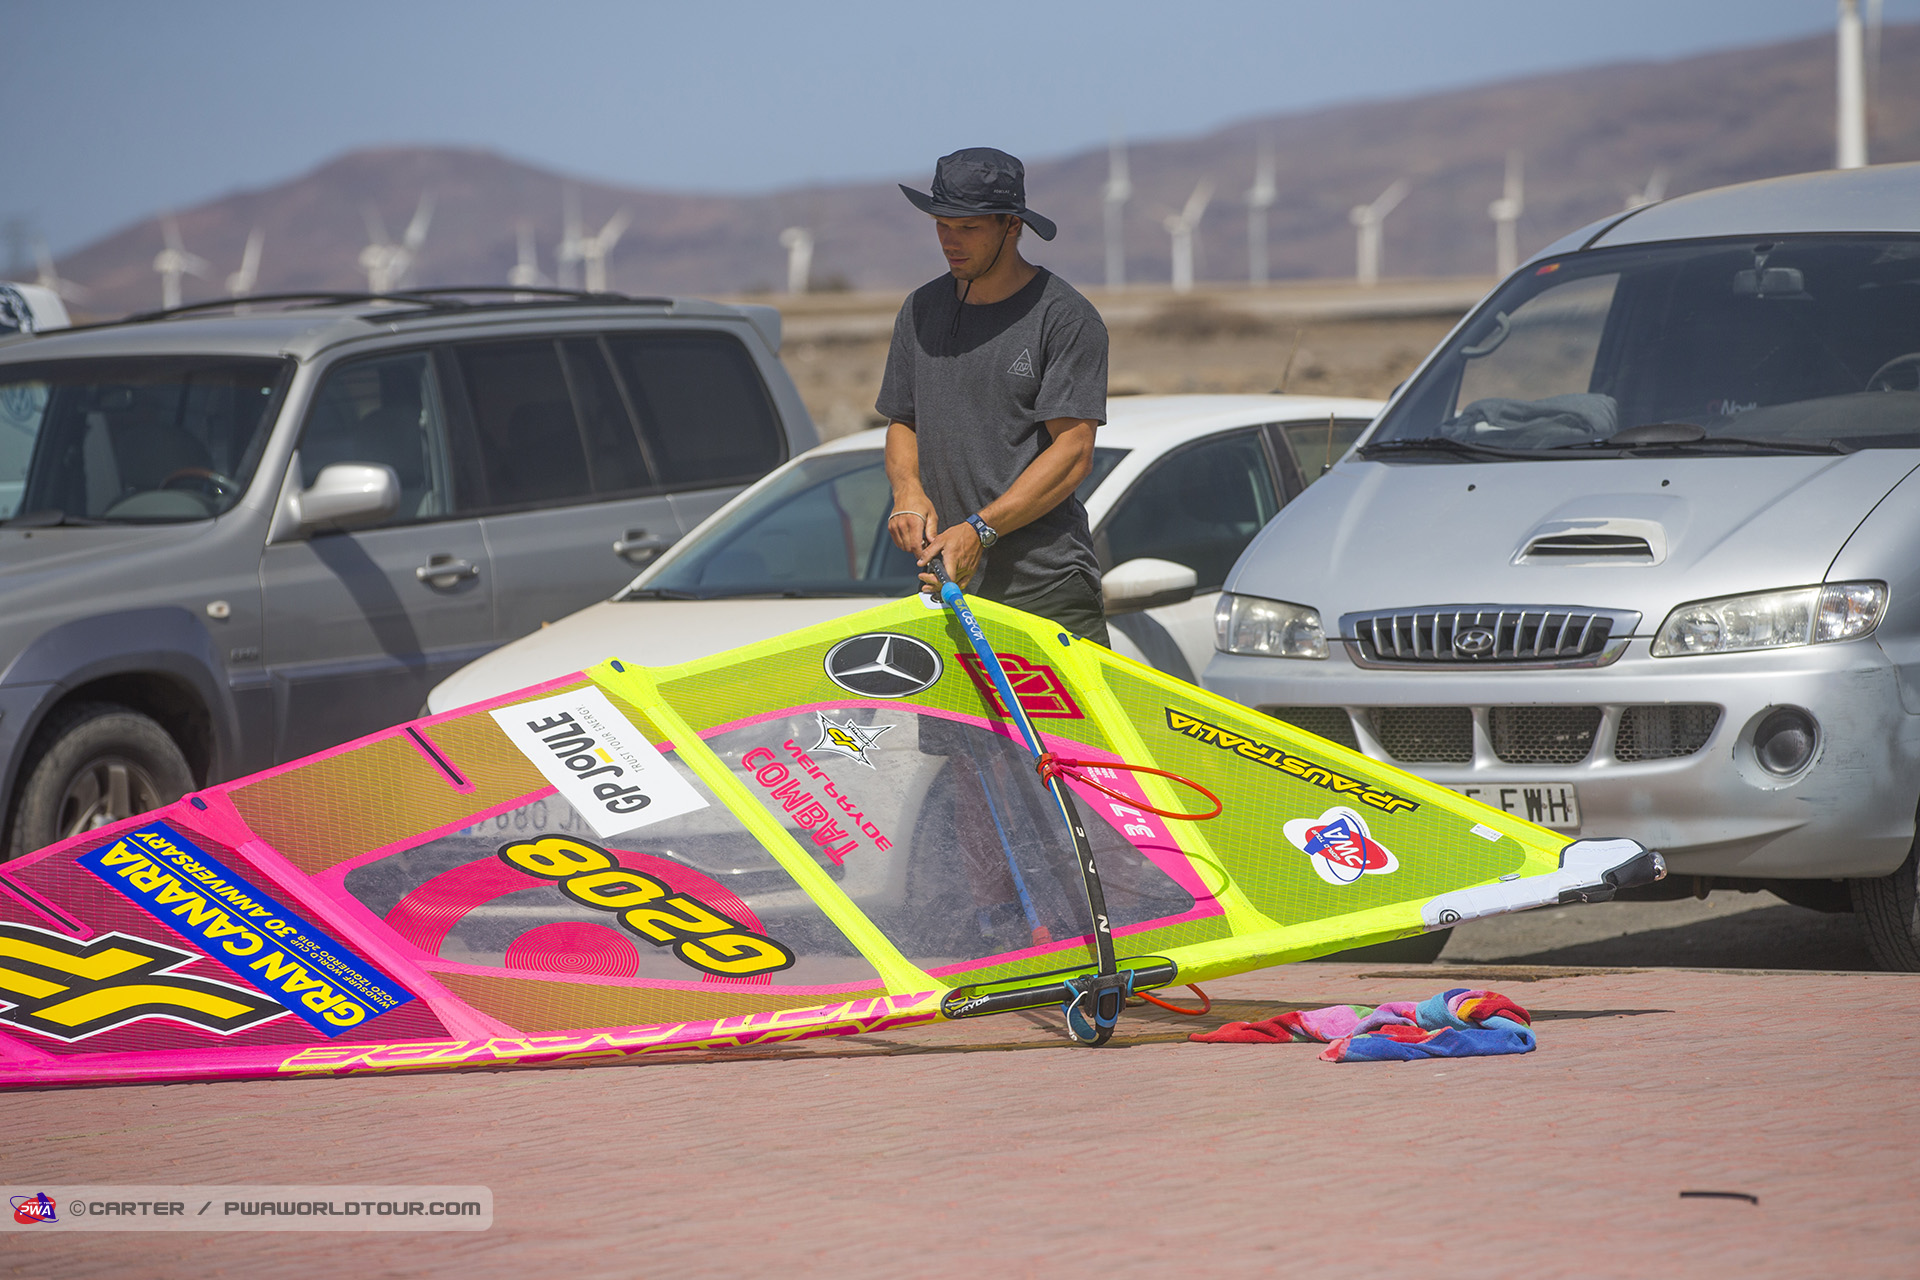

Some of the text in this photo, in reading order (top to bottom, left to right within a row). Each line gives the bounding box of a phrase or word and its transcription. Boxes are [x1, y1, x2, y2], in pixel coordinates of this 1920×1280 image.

[526, 711, 652, 814] GP JOULE
[601, 731, 625, 752] YOUR
[620, 752, 646, 773] TRUST
[1166, 707, 1418, 813] JP-AUSTRALIA
[1109, 803, 1156, 838] 3.7
[1323, 826, 1371, 867] PWA
[134, 832, 298, 938] 30 ANNIVERSARY
[499, 834, 795, 977] G208
[100, 843, 366, 1027] GRAN CANARIA
[298, 935, 399, 1006] POZO IZQUIERDO 2018
[290, 939, 390, 1009] WINDSURF WORLD CUP
